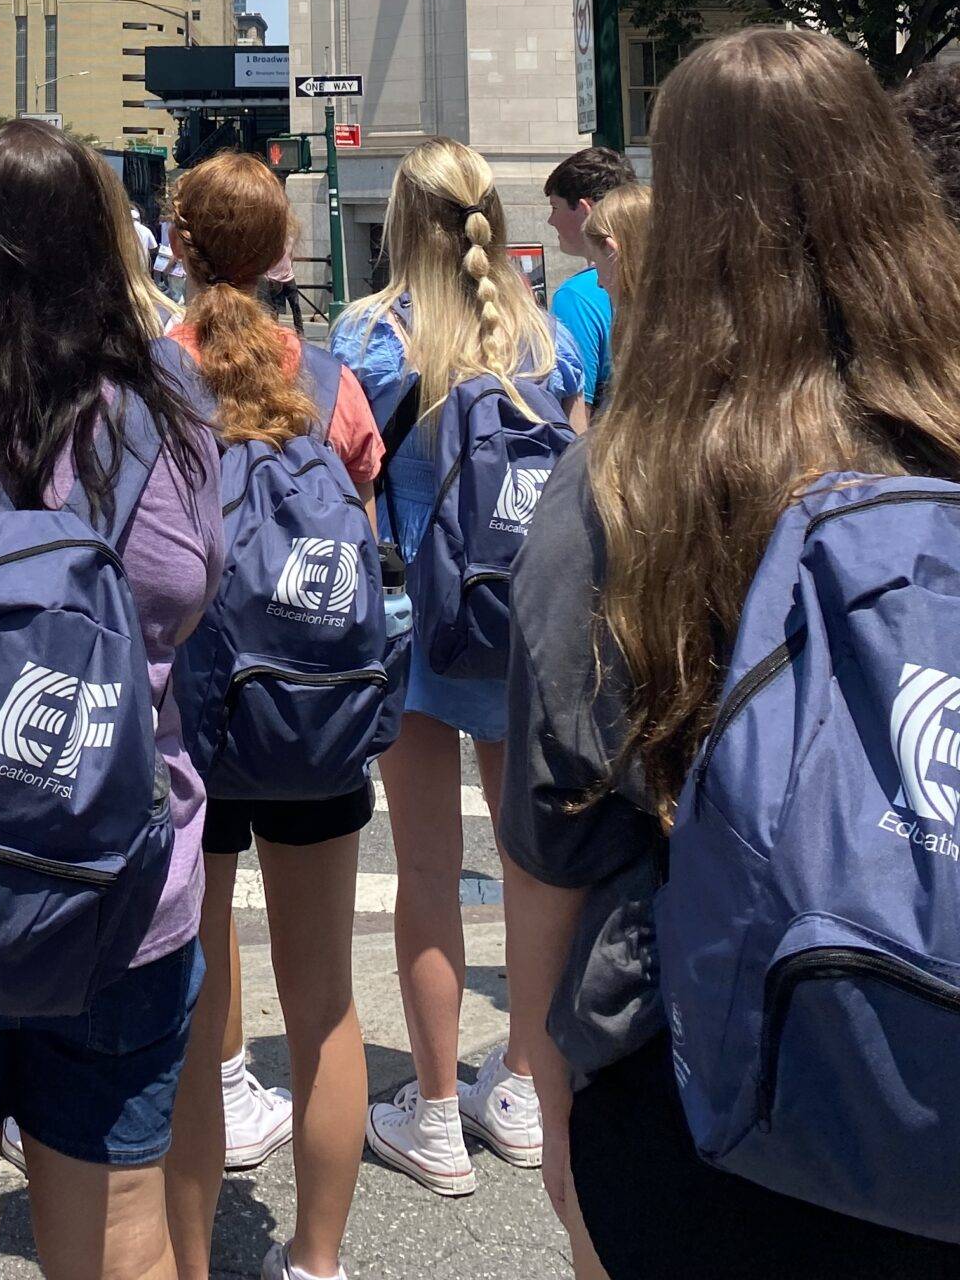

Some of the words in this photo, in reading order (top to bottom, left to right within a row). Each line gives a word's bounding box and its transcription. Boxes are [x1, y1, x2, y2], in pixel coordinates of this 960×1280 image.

[246, 55, 251, 63] 1
[305, 81, 325, 92] ONE
[333, 80, 355, 91] WAY
[266, 603, 321, 625] Education
[321, 614, 346, 628] First
[42, 777, 73, 800] First
